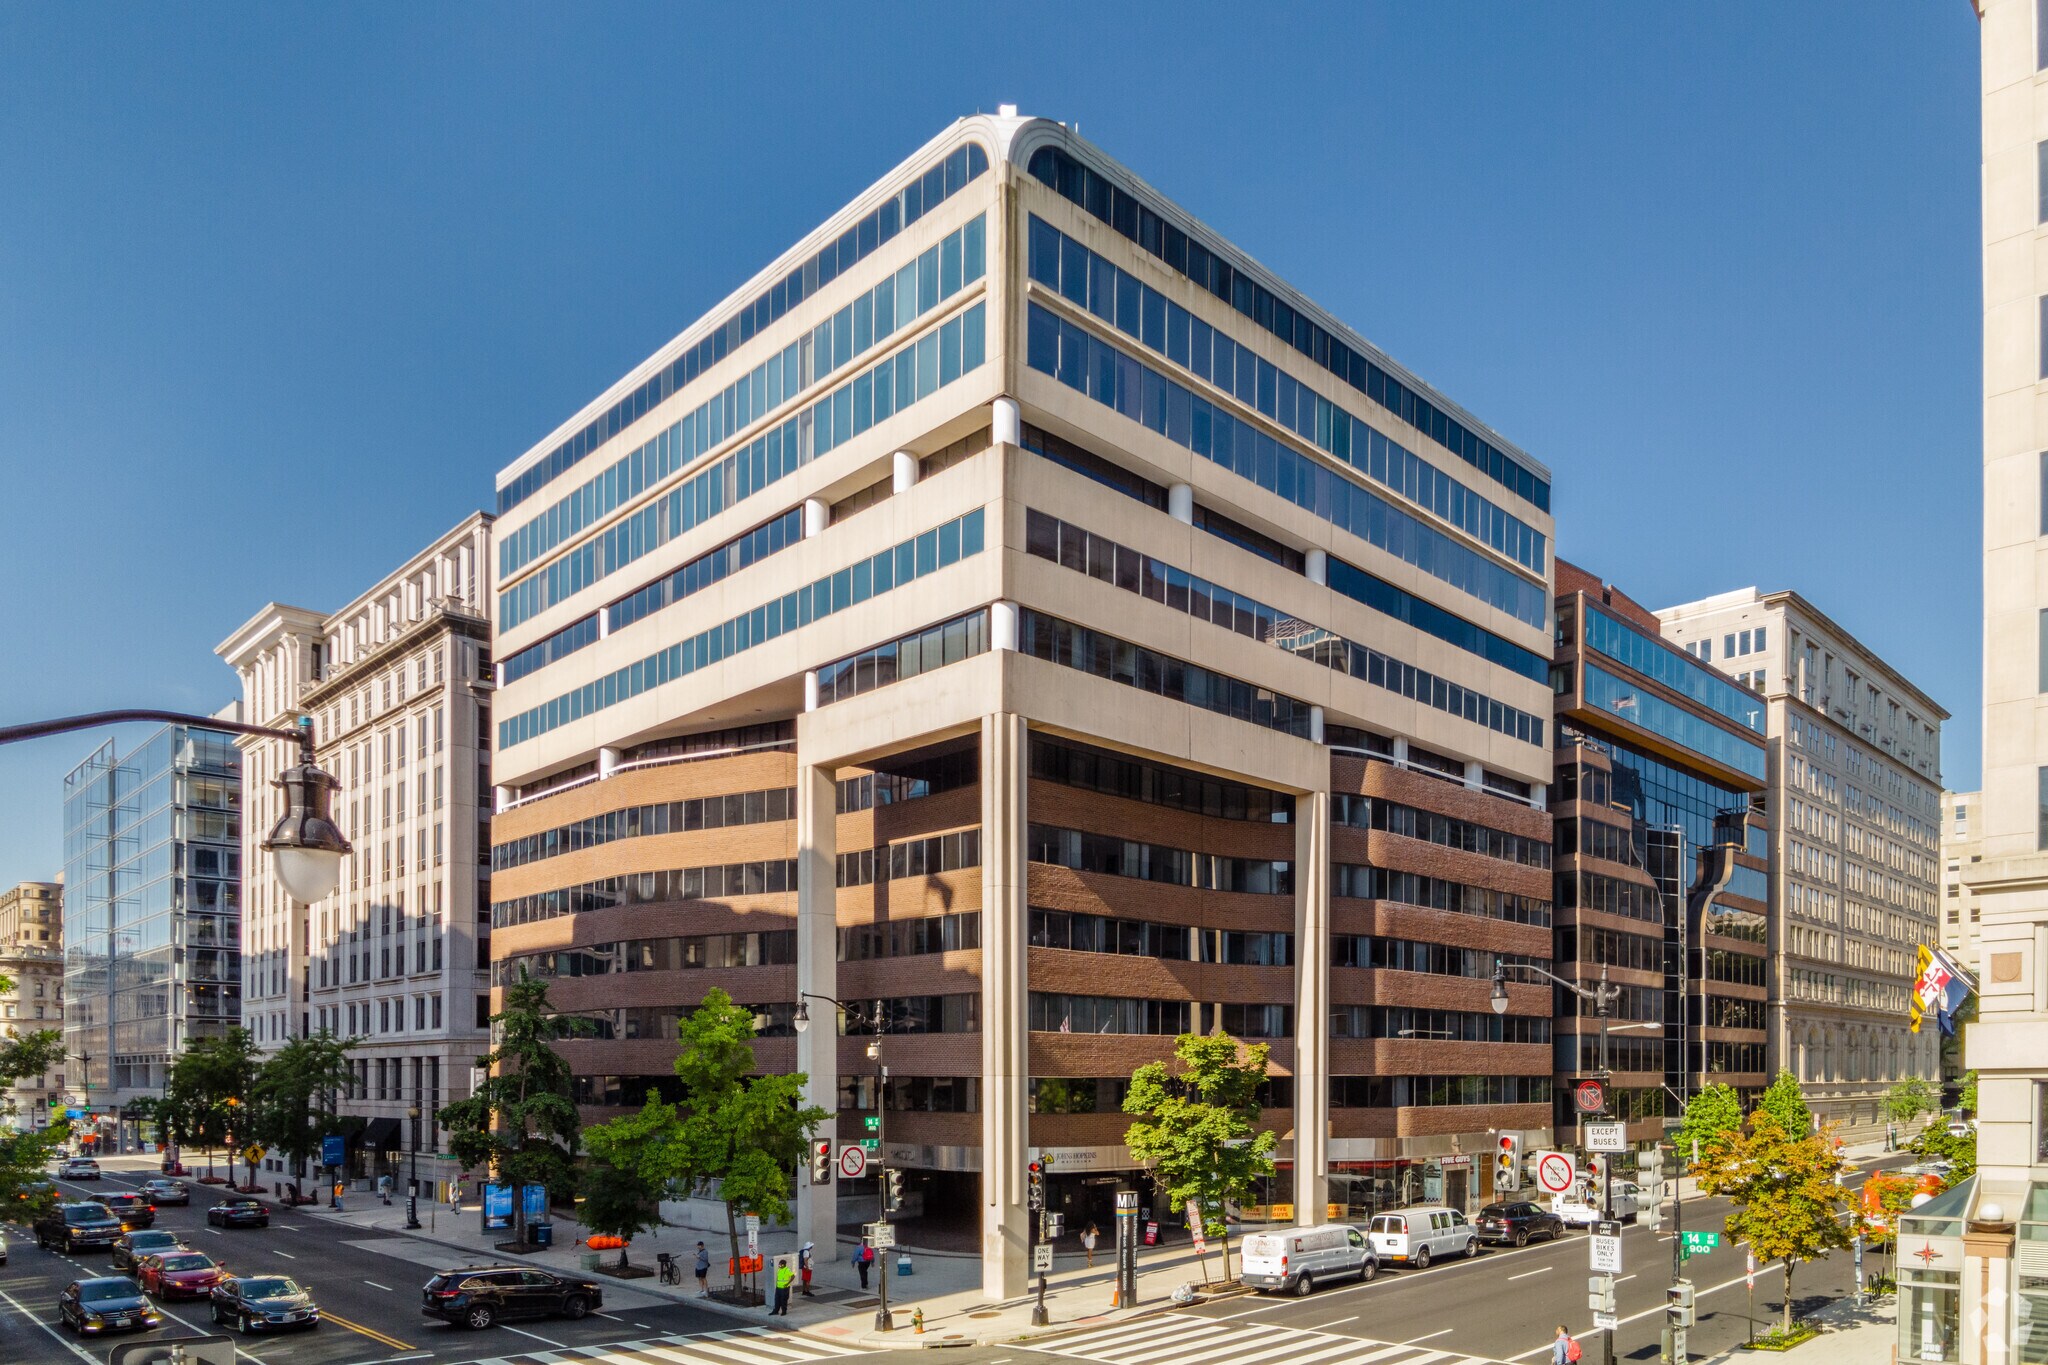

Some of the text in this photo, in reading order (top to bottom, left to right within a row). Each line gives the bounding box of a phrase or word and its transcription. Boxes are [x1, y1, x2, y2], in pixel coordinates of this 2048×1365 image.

[1591, 1127, 1618, 1135] EXCEPT
[1593, 1138, 1617, 1146] BUSES
[1441, 1155, 1470, 1164] FIVE GUYS
[1117, 1194, 1127, 1208] M
[1127, 1193, 1138, 1207] M
[1687, 1233, 1700, 1245] 14
[1595, 1244, 1615, 1252] BIKES
[1689, 1244, 1710, 1253] 900
